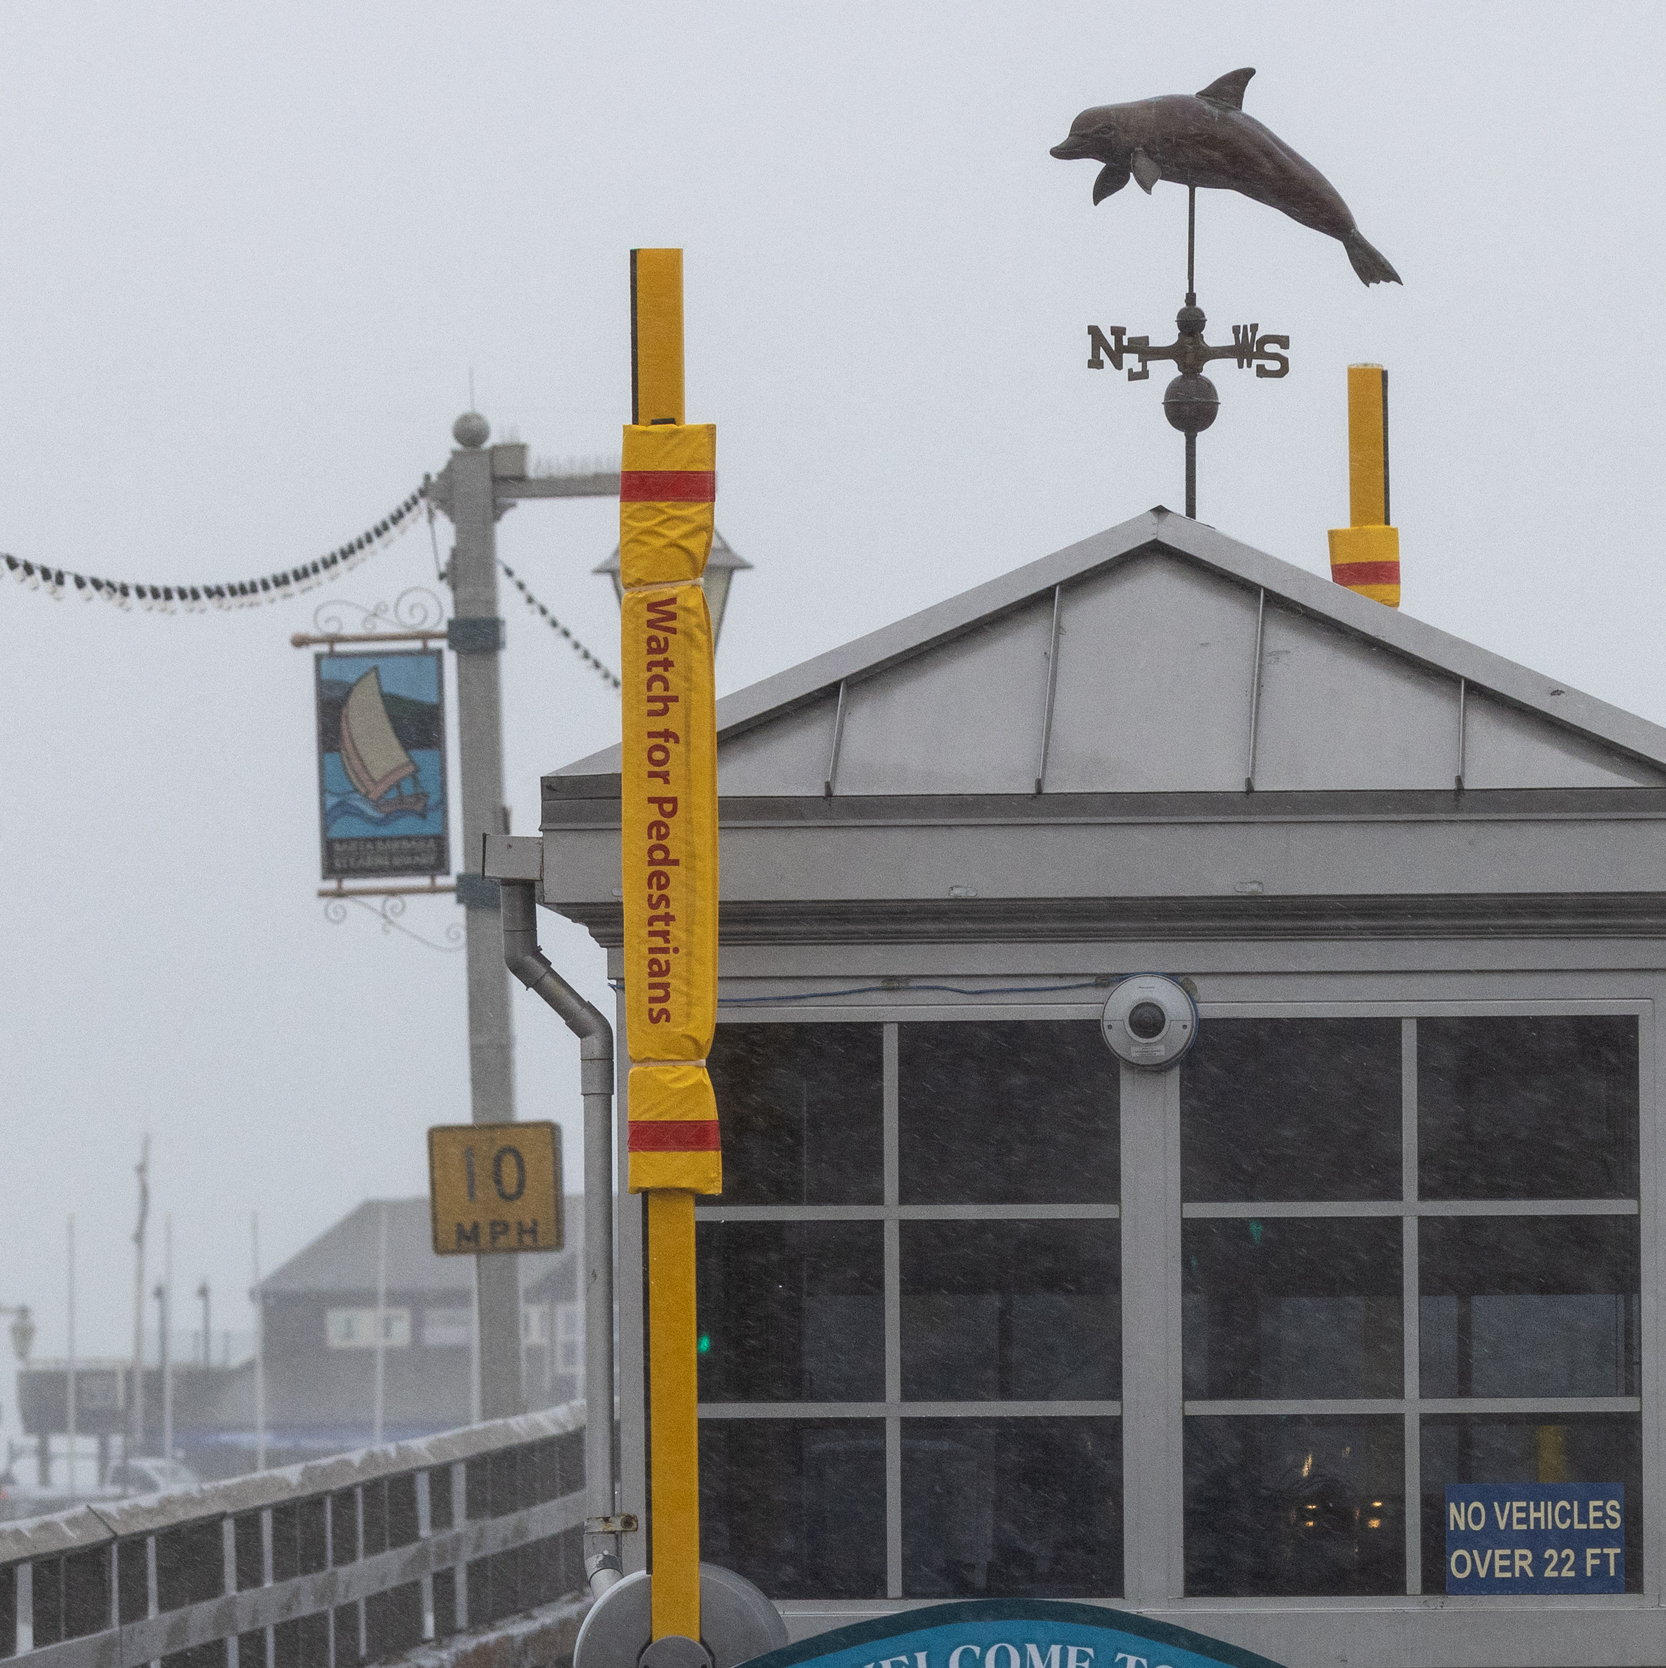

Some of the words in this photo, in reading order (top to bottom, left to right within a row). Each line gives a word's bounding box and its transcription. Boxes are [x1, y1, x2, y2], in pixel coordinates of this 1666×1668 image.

[645, 596, 680, 718] Watch
[646, 728, 680, 785] for
[646, 796, 680, 1026] Pedestrians
[463, 1144, 527, 1204] 10
[456, 1219, 540, 1249] MPH
[1449, 1501, 1486, 1531] NO
[1494, 1499, 1622, 1531] VEHICLES
[1450, 1548, 1534, 1579] OVER
[1543, 1548, 1576, 1578] 22
[1585, 1547, 1621, 1577] FT
